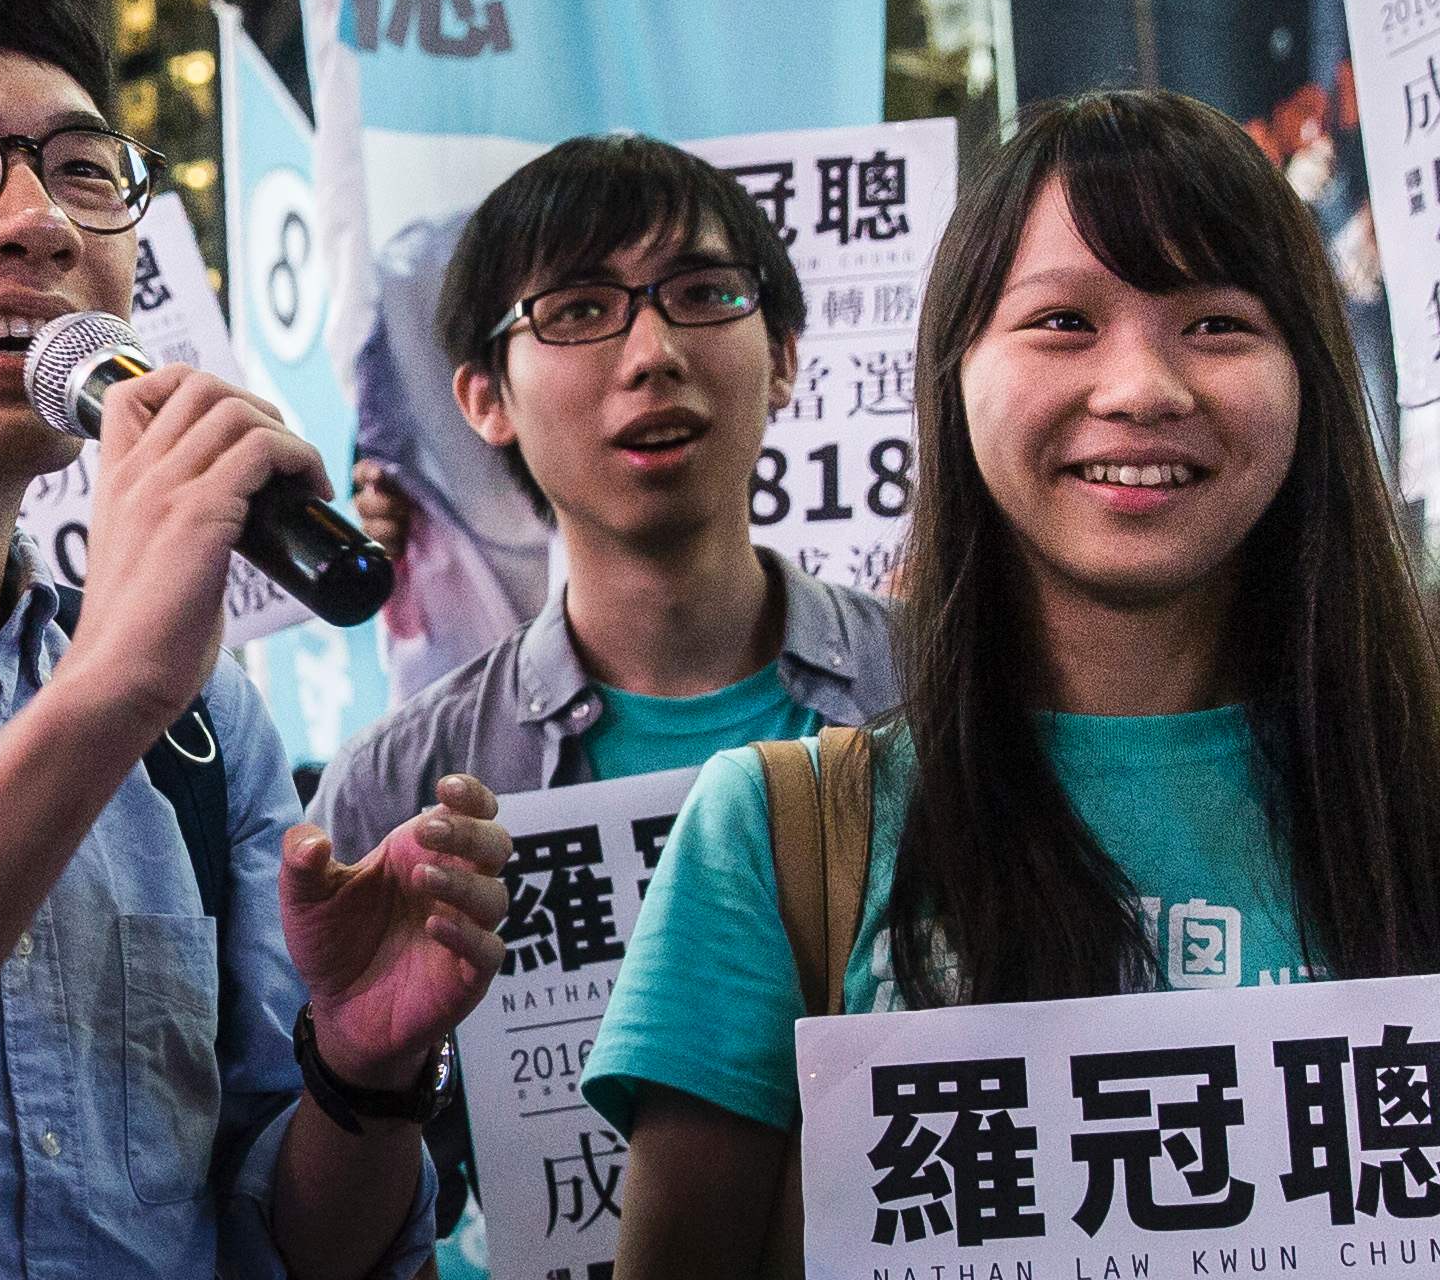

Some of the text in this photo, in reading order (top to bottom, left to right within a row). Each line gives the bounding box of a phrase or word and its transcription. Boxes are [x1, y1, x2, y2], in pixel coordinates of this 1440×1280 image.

[268, 211, 310, 326] 8
[805, 286, 917, 327] 轉勝
[499, 812, 685, 977] 羅
[1192, 1246, 1298, 1275] KWUN
